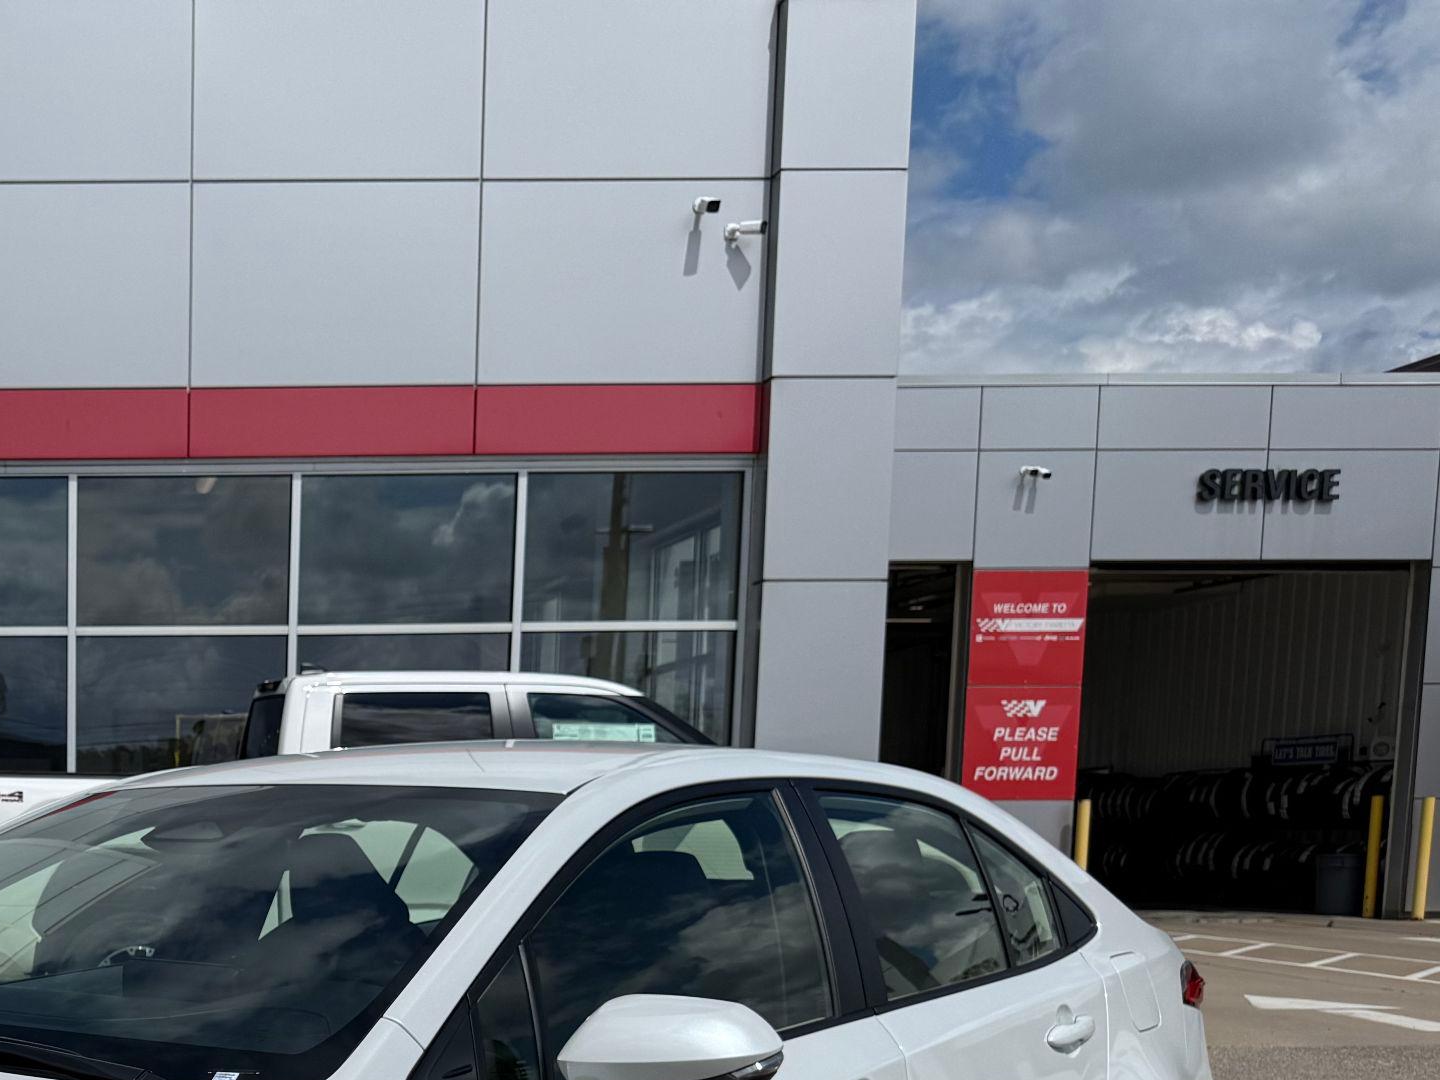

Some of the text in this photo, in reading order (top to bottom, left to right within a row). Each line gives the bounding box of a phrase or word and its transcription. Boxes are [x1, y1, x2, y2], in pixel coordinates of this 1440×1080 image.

[1197, 468, 1341, 502] SERVICE
[993, 602, 1067, 614] WELCOME TO
[993, 727, 1060, 742] PLEASE
[999, 747, 1042, 761] PULL
[974, 766, 1058, 781] FORWARD
